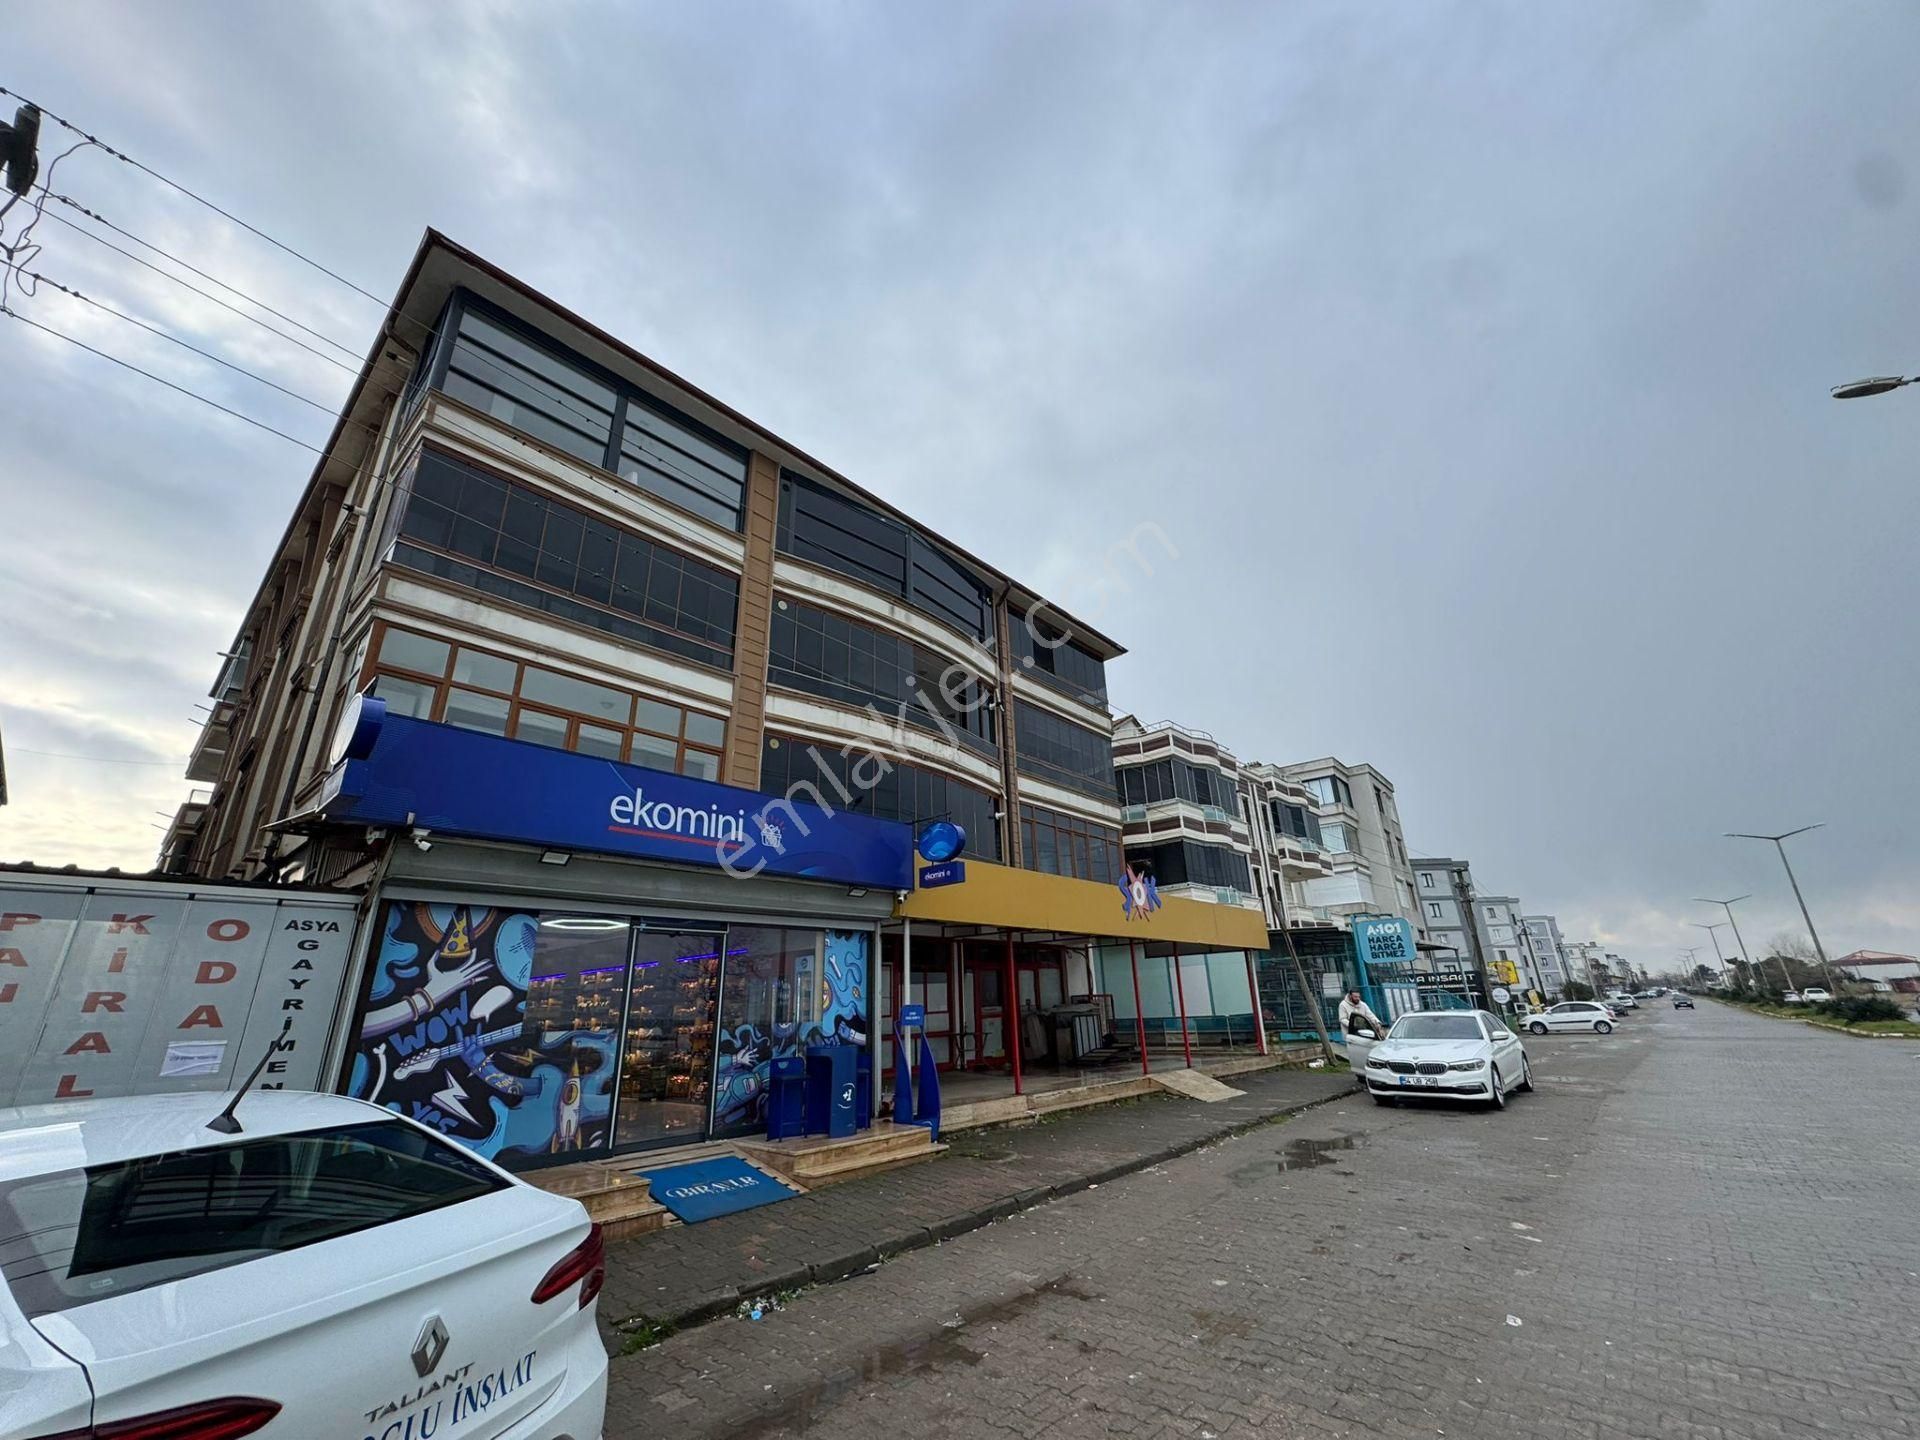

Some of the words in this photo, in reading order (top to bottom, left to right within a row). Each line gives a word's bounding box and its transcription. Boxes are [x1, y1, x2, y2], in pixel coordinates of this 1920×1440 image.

[610, 788, 745, 842] ekomini
[284, 919, 340, 933] ASYA
[1367, 934, 1404, 944] HARCA
[1369, 942, 1405, 952] HARCA
[177, 918, 251, 1030] ODA
[388, 990, 469, 1057] WOW
[363, 1361, 477, 1424] TALIANT
[450, 1350, 538, 1426] İNŞAAT
